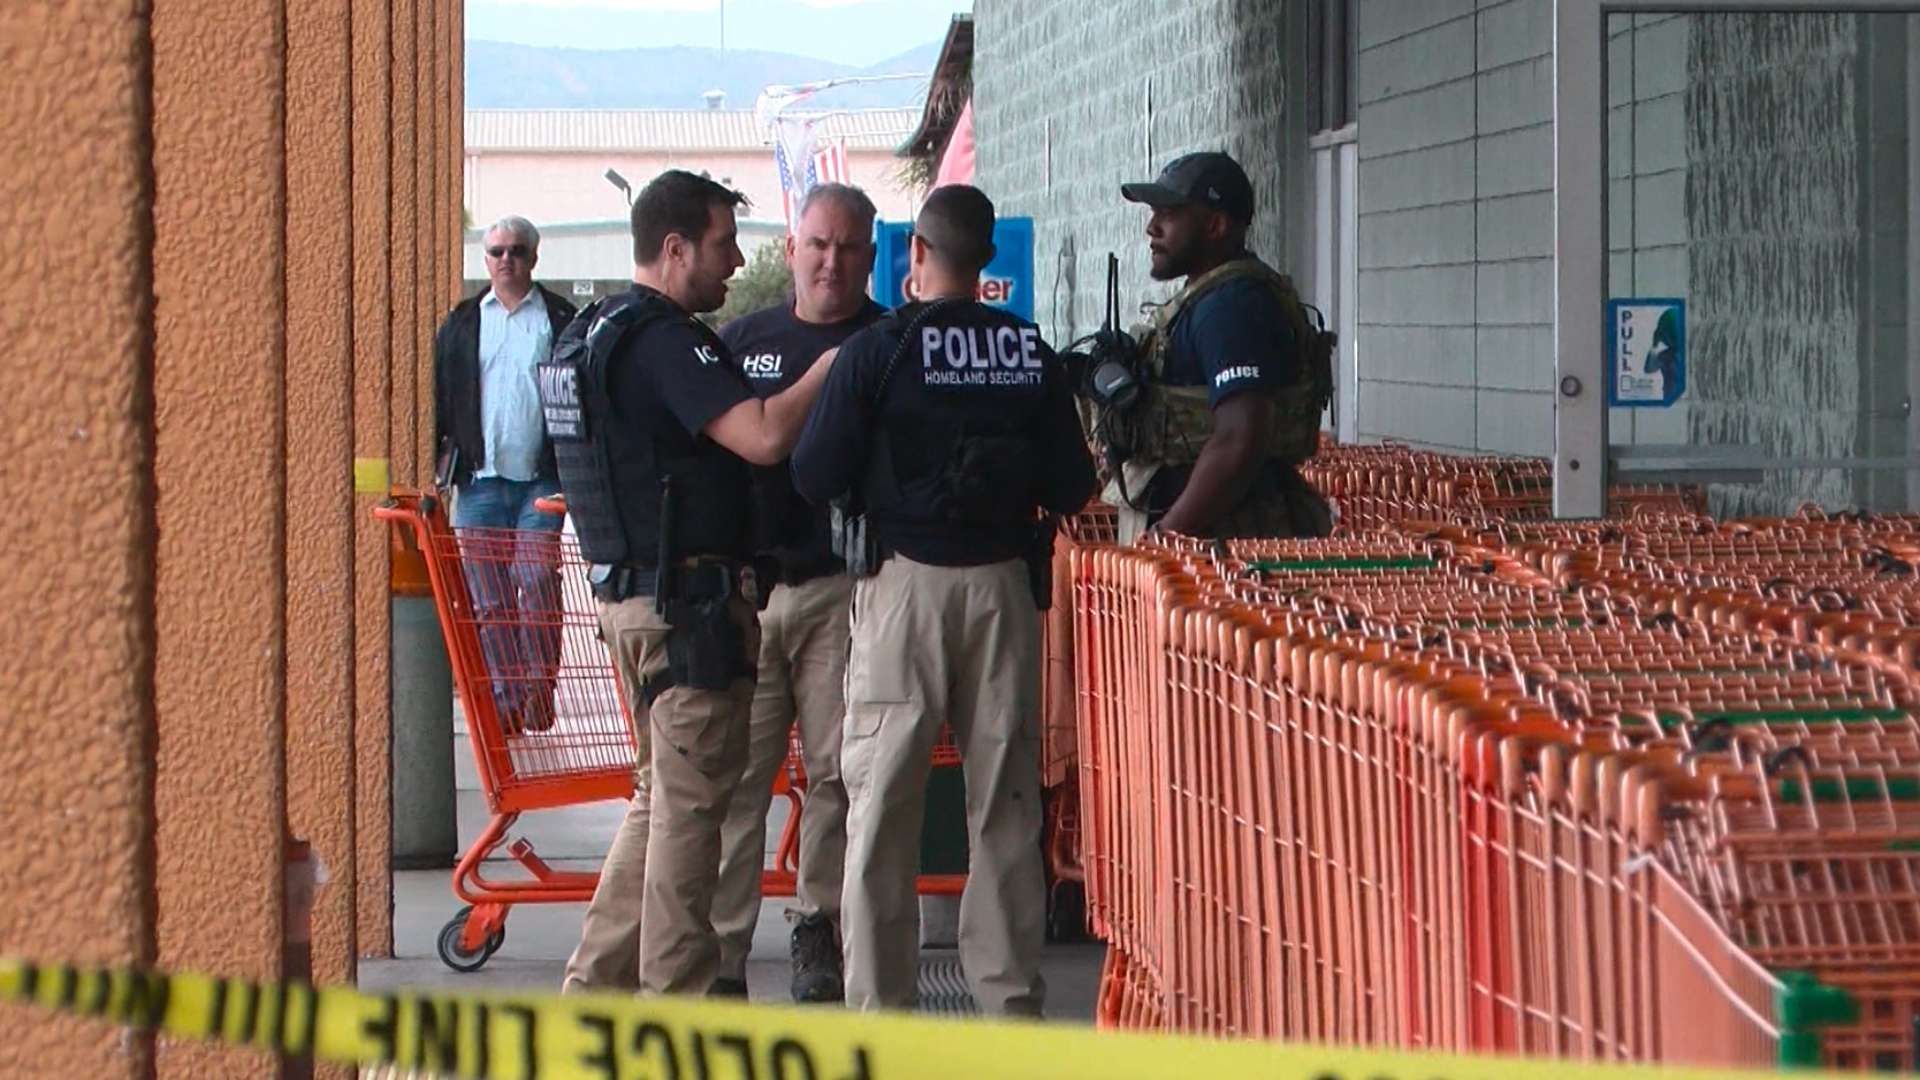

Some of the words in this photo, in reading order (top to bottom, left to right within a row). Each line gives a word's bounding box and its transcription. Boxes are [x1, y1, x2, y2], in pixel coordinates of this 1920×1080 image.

[922, 326, 1042, 368] POLICE
[1621, 310, 1633, 373] PULL
[743, 354, 782, 372] HSI
[925, 370, 985, 384] HOMELAND
[989, 370, 1042, 384] SECURITY
[1215, 366, 1260, 388] POLICE
